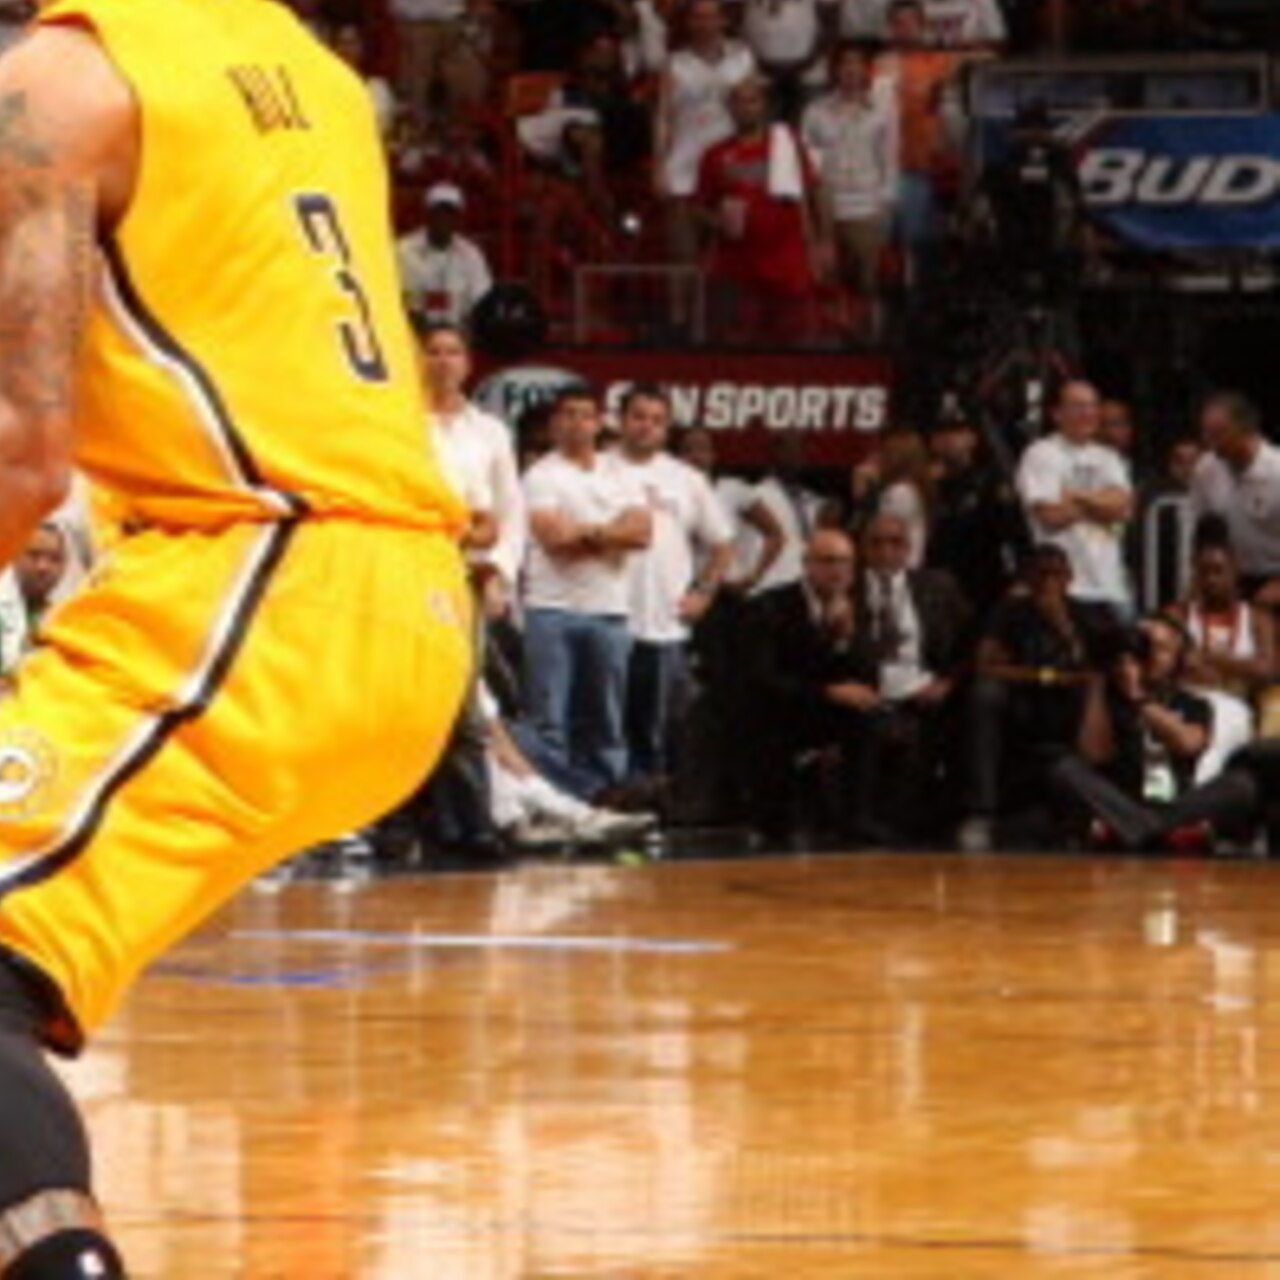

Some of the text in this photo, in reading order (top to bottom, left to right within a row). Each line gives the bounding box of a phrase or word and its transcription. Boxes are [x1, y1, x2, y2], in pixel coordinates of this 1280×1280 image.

[1078, 147, 1279, 207] BUD
[293, 193, 388, 382] 3
[603, 380, 888, 433] SN SPORTS
